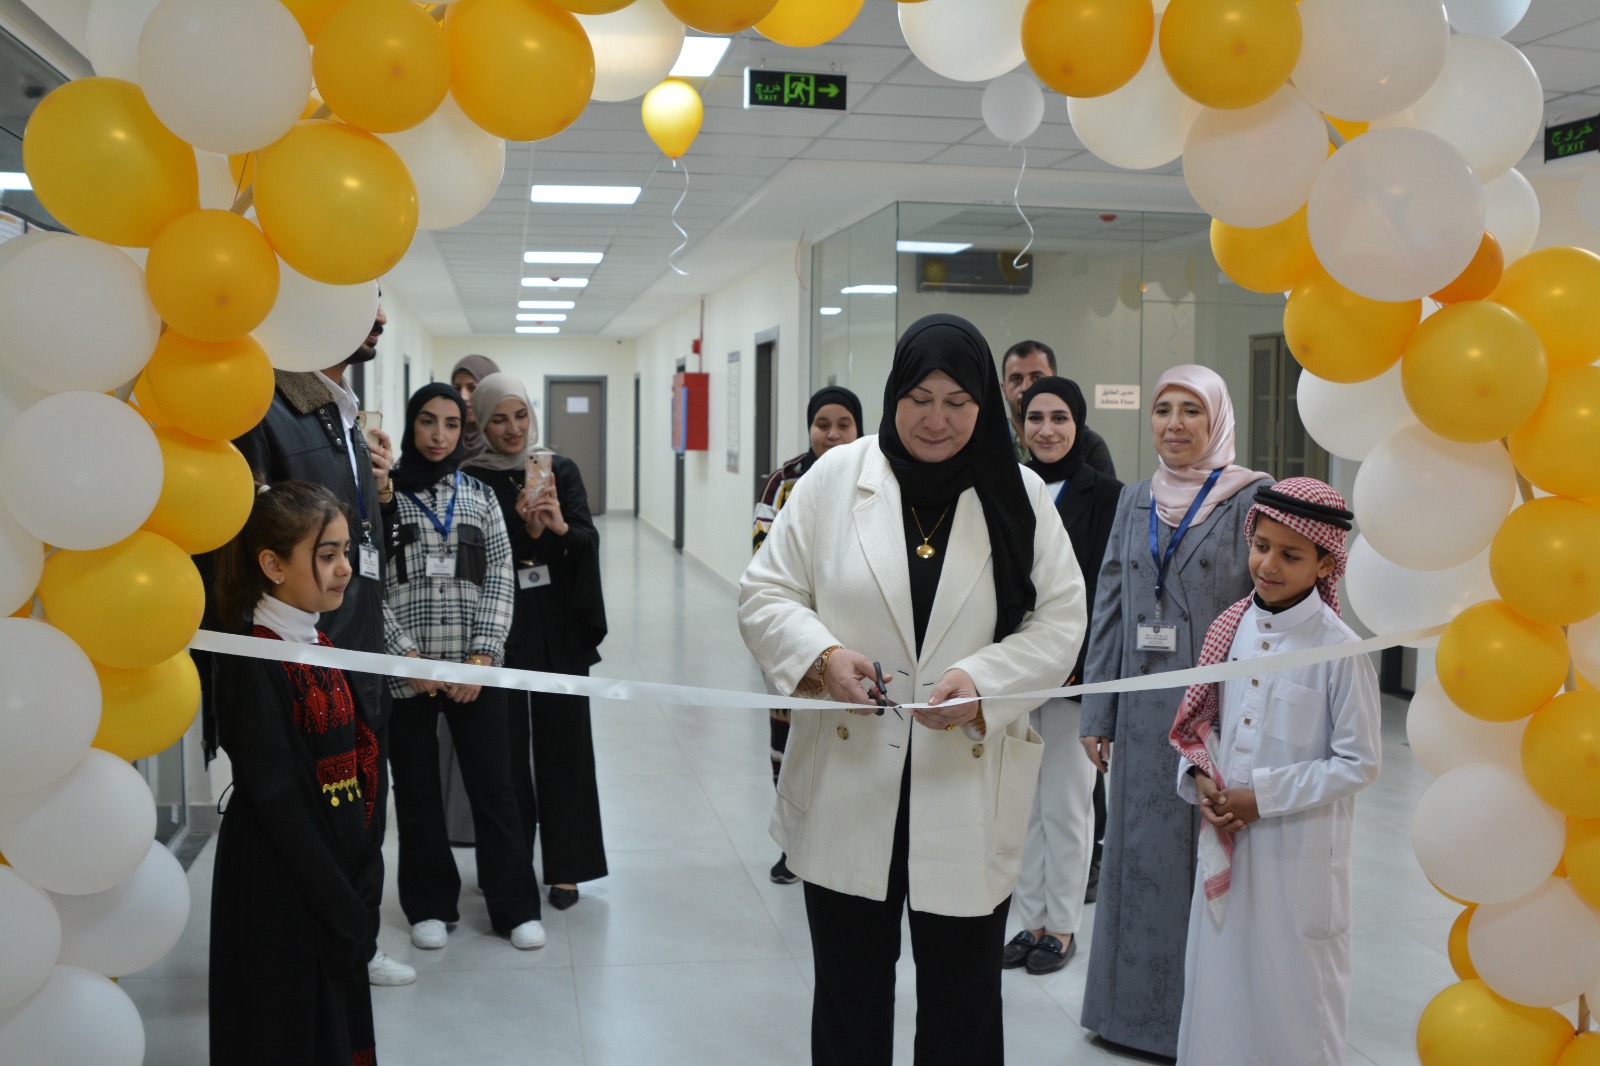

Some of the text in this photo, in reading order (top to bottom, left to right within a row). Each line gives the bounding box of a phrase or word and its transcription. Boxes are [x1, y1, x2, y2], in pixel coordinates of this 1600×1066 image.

[755, 82, 781, 94] خروج
[1551, 121, 1593, 146] خروج
[1558, 140, 1585, 156] EXIT
